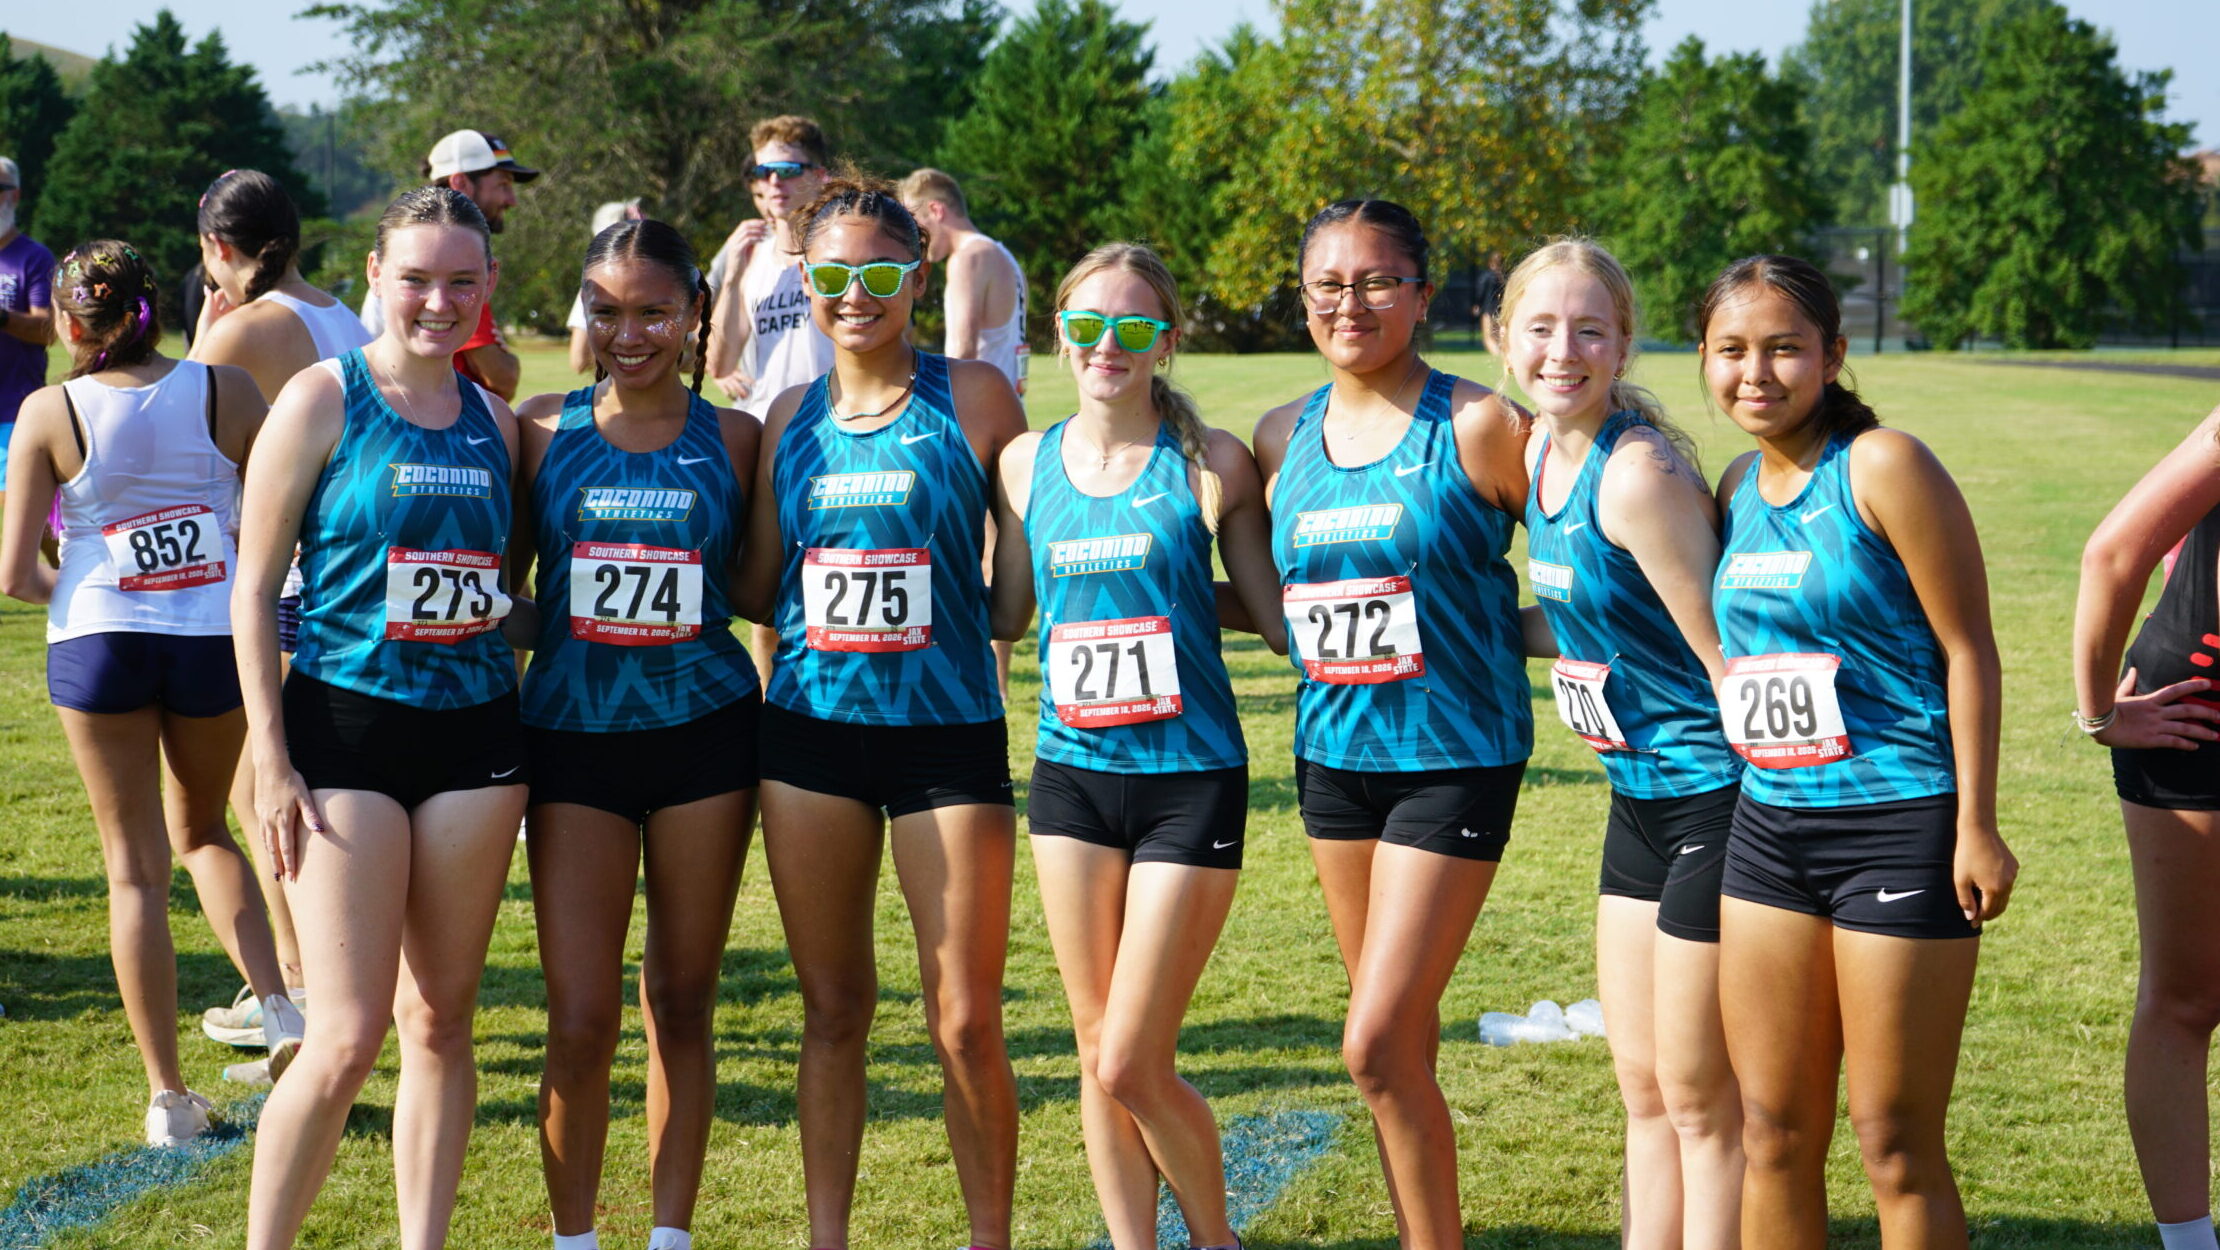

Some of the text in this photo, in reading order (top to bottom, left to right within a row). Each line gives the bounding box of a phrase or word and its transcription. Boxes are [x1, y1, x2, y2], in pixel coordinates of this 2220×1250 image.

[397, 465, 490, 487] COCONINO
[410, 485, 480, 496] ATHLETICS
[812, 473, 911, 497] COCONINO
[583, 488, 693, 509] COCONINO
[822, 494, 893, 506] ATHLETICS
[116, 505, 202, 531] SOUTHERN SHOWCASE
[595, 509, 674, 519] ATHLETICS
[129, 519, 206, 572] 852
[1053, 535, 1149, 564] COCONINO
[405, 551, 494, 566] SOUTHERN SHOWCASE
[588, 546, 690, 561] SOUTHERN SHOWCASE
[817, 552, 918, 565] SOUTHERN SHOWCASE
[1065, 559, 1131, 574] ATHLETICS
[412, 567, 493, 620] 273
[594, 563, 681, 623] 274
[1345, 582, 1398, 597] SHOWCASE
[825, 570, 908, 626] 275
[414, 628, 458, 637] SEPTEMBER
[597, 624, 638, 636] SEPTEMBER
[651, 628, 671, 637] 2026
[1062, 621, 1158, 640] SOUTHERN SHOWCASE
[1308, 600, 1397, 658] 272
[829, 632, 869, 642] SEPTEMBER
[882, 633, 902, 641] 2026
[902, 634, 926, 645] STATE
[1071, 640, 1152, 701] 271
[1323, 666, 1360, 675] SEPTEMBER
[1393, 663, 1418, 675] STATE
[1079, 705, 1119, 718] SEPTEMBER
[1132, 703, 1151, 713] 2026
[1152, 703, 1178, 715] STATE
[1558, 677, 1608, 738] 270
[1740, 675, 1818, 740] 269
[1817, 745, 1845, 759] STATE
